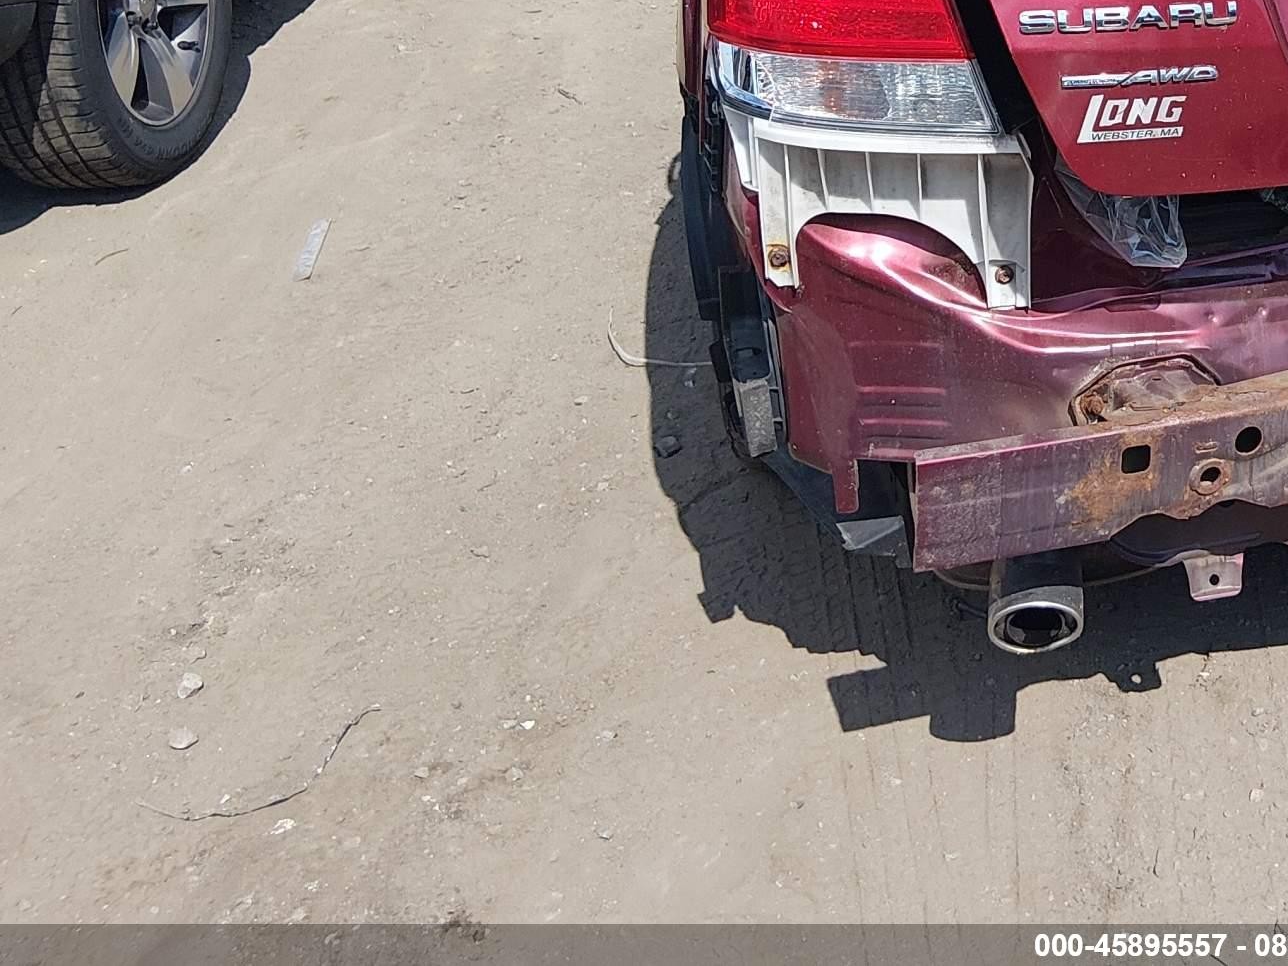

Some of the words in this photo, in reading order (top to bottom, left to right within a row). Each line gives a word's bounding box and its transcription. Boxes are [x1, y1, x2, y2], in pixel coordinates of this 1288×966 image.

[1019, 0, 1238, 35] SUBARU
[1121, 65, 1218, 87] AWD
[1077, 94, 1187, 143] LONG
[1160, 128, 1180, 137] MA
